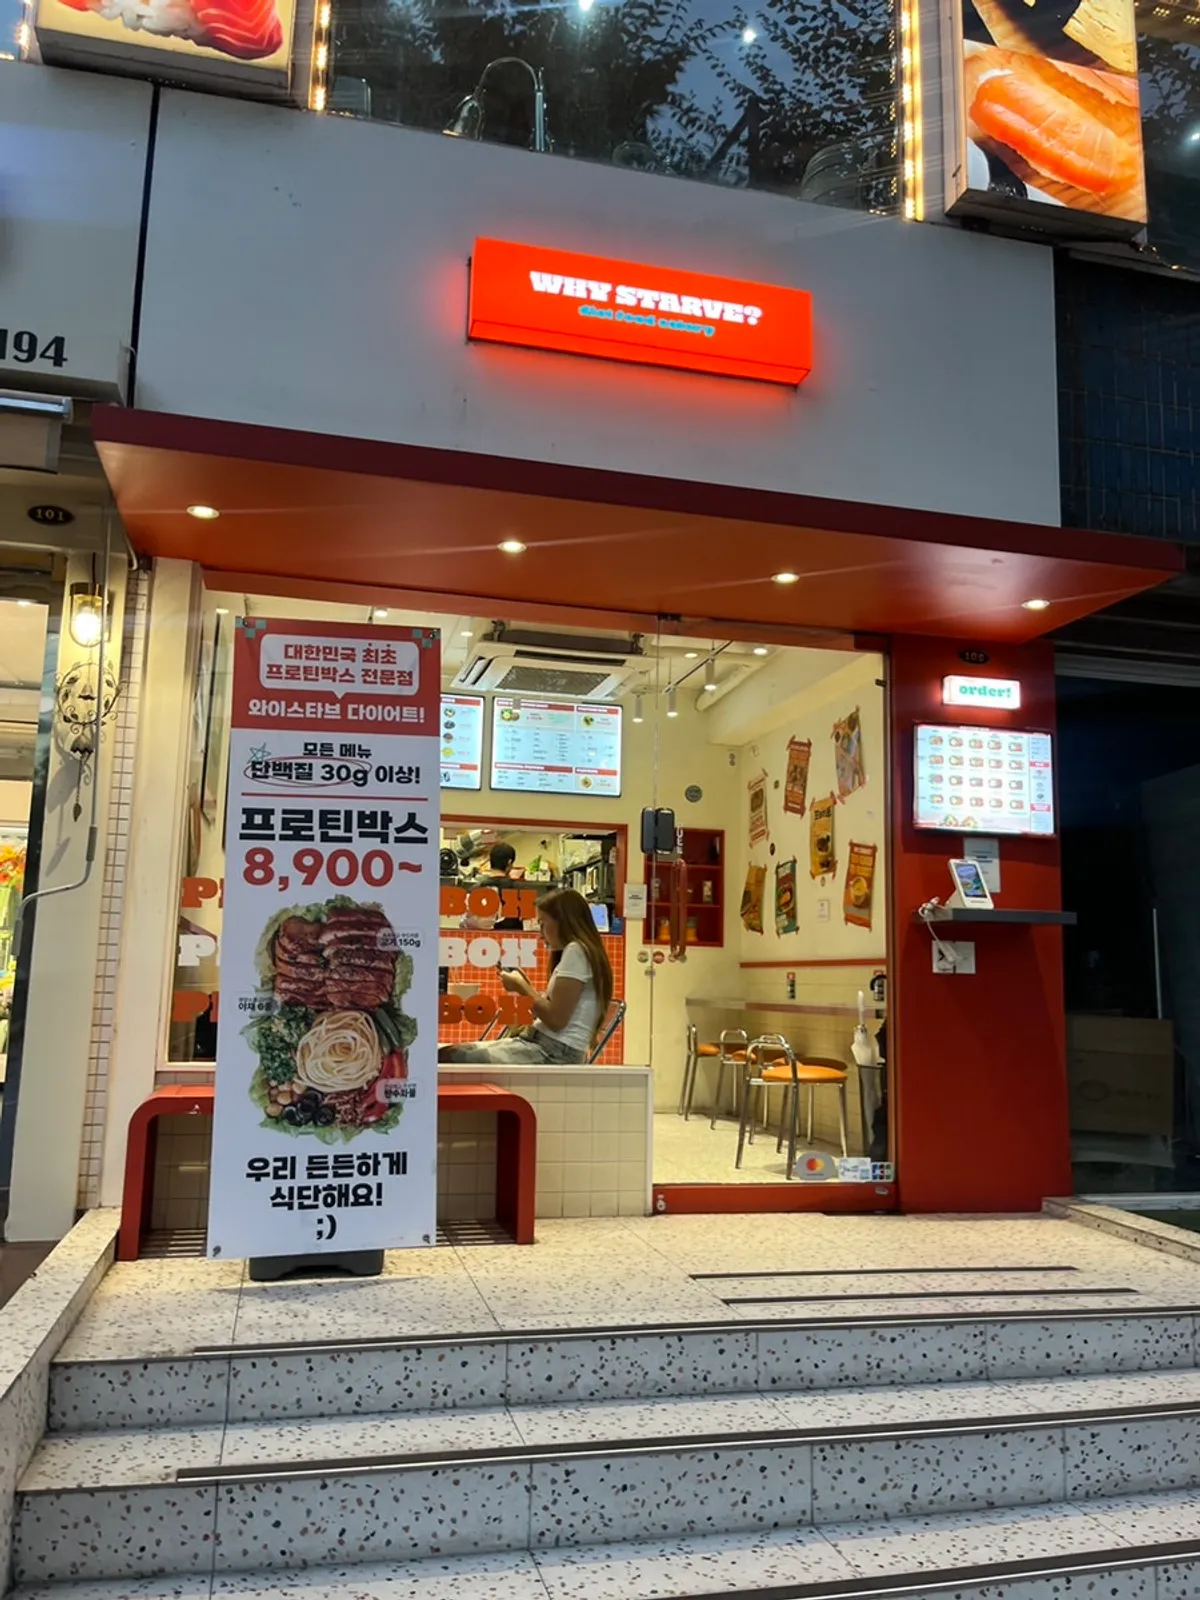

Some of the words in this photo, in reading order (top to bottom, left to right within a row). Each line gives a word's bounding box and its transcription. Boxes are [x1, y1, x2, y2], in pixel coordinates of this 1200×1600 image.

[528, 270, 612, 302] WHY
[615, 284, 763, 326] STARVE?
[614, 309, 656, 327] food
[658, 318, 716, 338] eatery
[36, 508, 64, 520] 101
[284, 644, 356, 664] 대한민국
[362, 642, 397, 664] 최초
[266, 664, 356, 683] 프로틴박스
[361, 668, 414, 686] 전문점
[959, 684, 1012, 698] order!
[248, 699, 341, 720] 와이스타브
[347, 704, 425, 723] 다이어트!
[303, 742, 334, 757] 모든
[340, 744, 372, 758] 메뉴
[250, 760, 313, 781] 단백질
[320, 764, 368, 787] 30g
[374, 766, 420, 784] 이상!
[239, 807, 428, 844] 프로틴박스
[242, 846, 422, 892] 8,900~
[439, 886, 538, 918] BOX
[398, 938, 421, 948] 150g
[438, 937, 538, 968] BOX
[246, 1156, 296, 1182] 우리
[306, 1152, 408, 1179] 든든하게
[270, 1182, 383, 1210] 식단해요!
[316, 1214, 337, 1240] ;)
